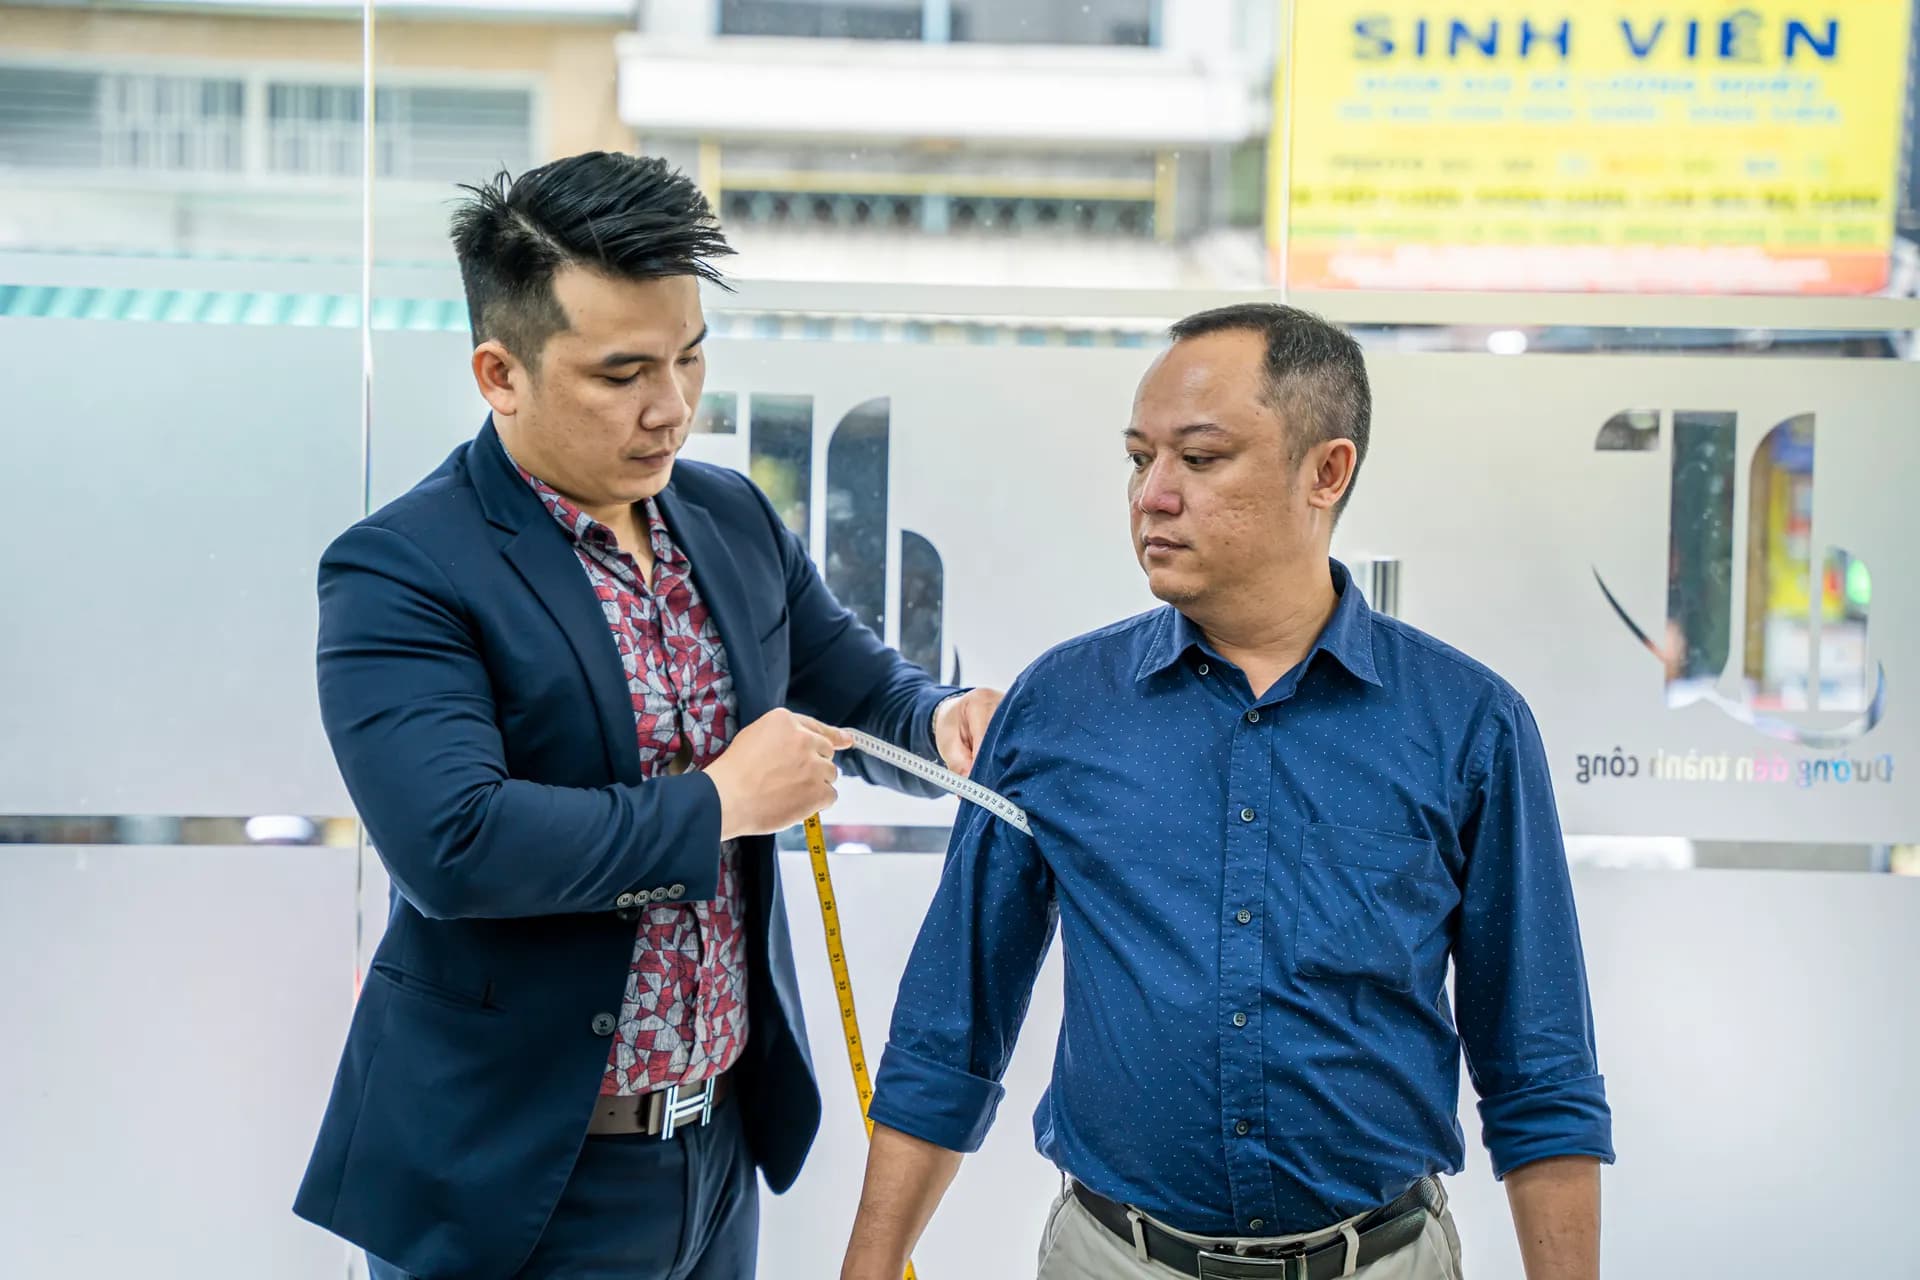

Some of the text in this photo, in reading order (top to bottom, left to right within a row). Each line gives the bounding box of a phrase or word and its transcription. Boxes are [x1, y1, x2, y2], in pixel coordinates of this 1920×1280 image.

[1353, 10, 1839, 61] SINH VIÊN
[812, 845, 821, 855] 27
[824, 900, 833, 911] 29
[833, 953, 841, 963] 31
[838, 981, 846, 991] 32
[849, 1035, 857, 1045] 34
